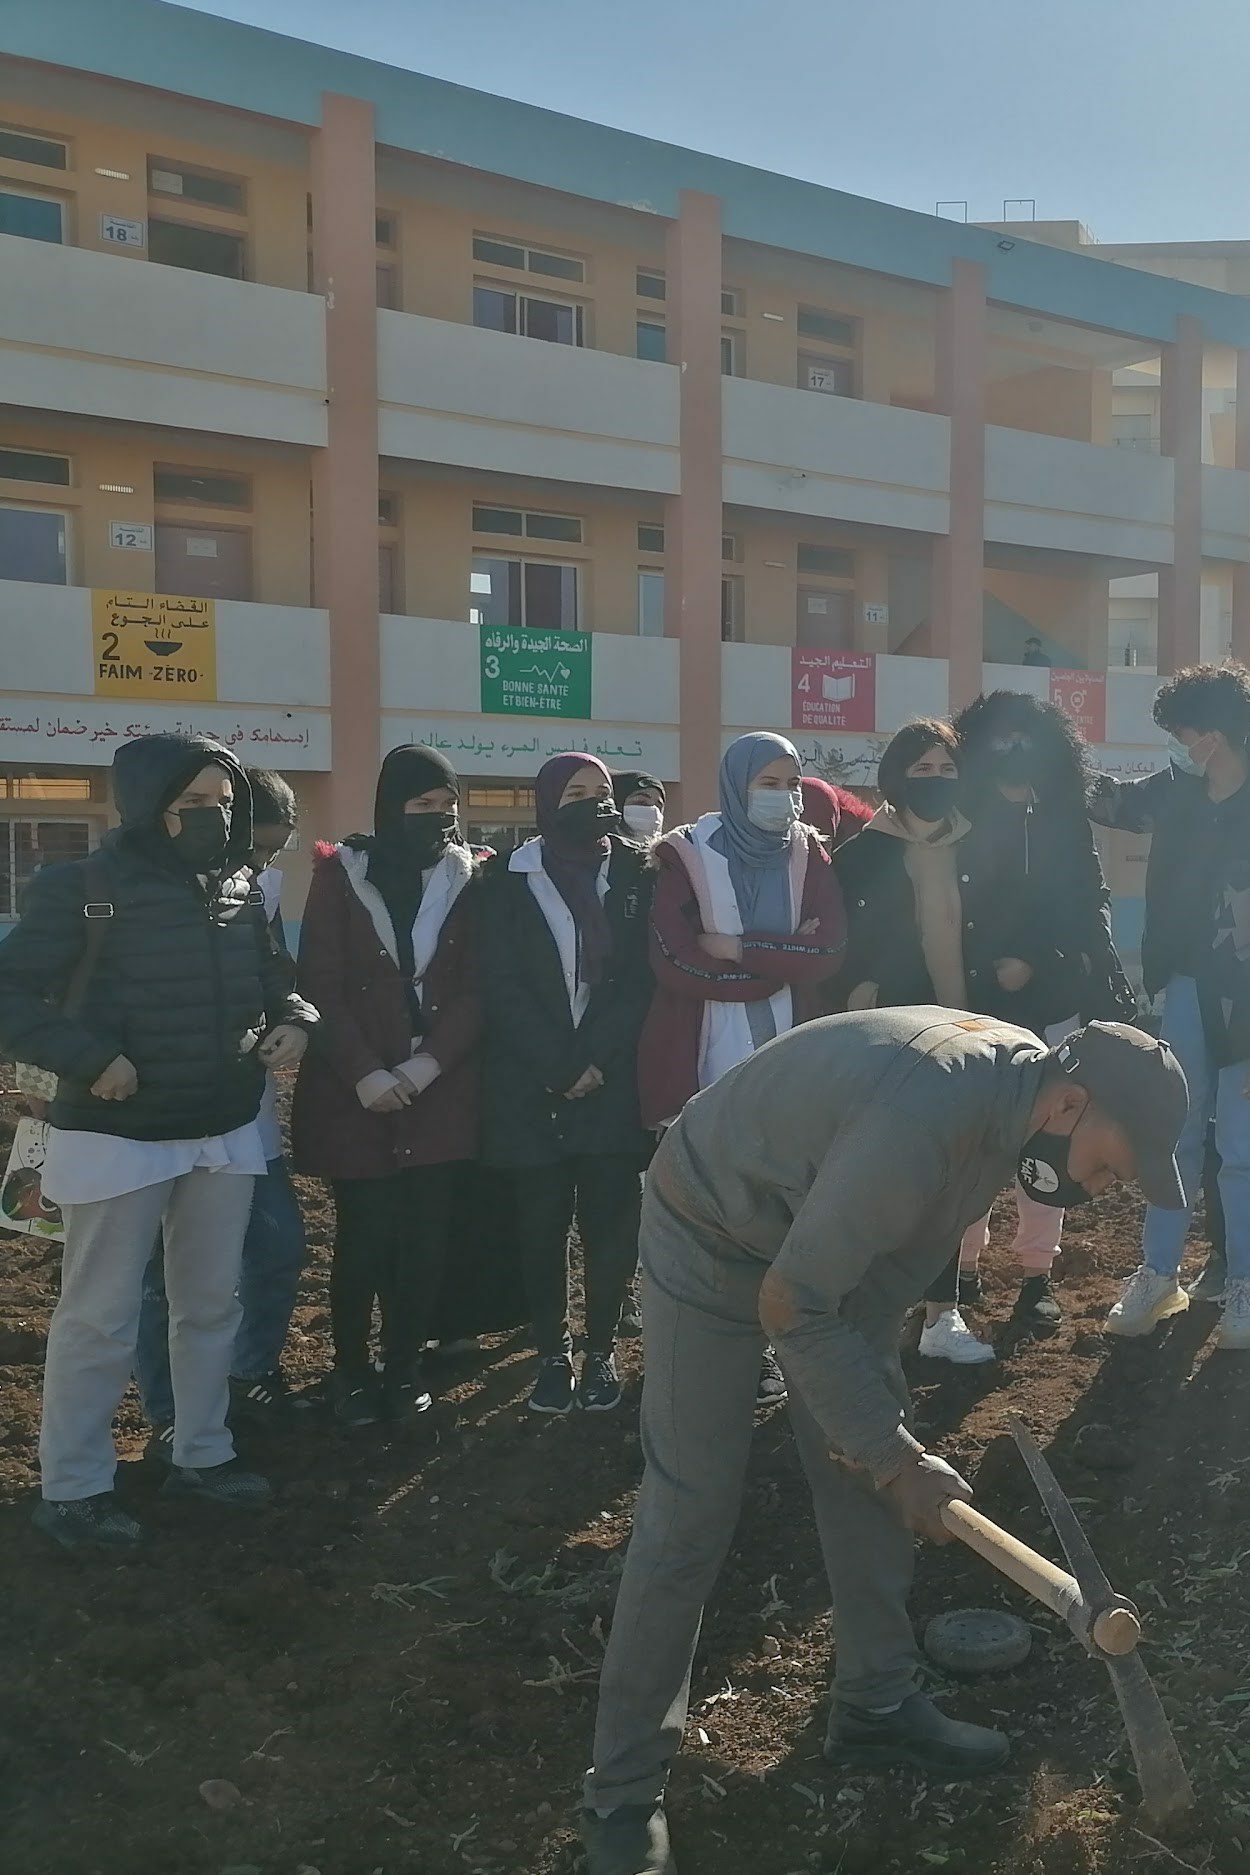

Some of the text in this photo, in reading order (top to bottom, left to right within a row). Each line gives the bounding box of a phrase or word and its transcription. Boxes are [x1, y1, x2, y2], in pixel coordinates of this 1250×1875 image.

[106, 226, 127, 241] 18
[811, 375, 825, 387] 17
[115, 533, 137, 547] 12
[105, 596, 208, 613] القضاء التام
[110, 612, 209, 628] على الجوع
[866, 611, 877, 621] 11
[101, 631, 121, 661] 2
[485, 631, 588, 655] الصحة الجيدة والرفاه
[99, 663, 143, 680] FAIM
[484, 654, 501, 679] 3
[799, 655, 872, 672] التعليم الجيد
[502, 680, 535, 694] BONNE
[797, 673, 811, 693] 4
[502, 694, 514, 706] ET
[1054, 688, 1063, 708] 5
[45, 716, 87, 737] ضمان
[802, 714, 813, 724] DE
[89, 723, 118, 742] خير
[457, 734, 495, 758] يولد
[501, 738, 540, 757] المرء
[596, 740, 643, 756] تعلم
